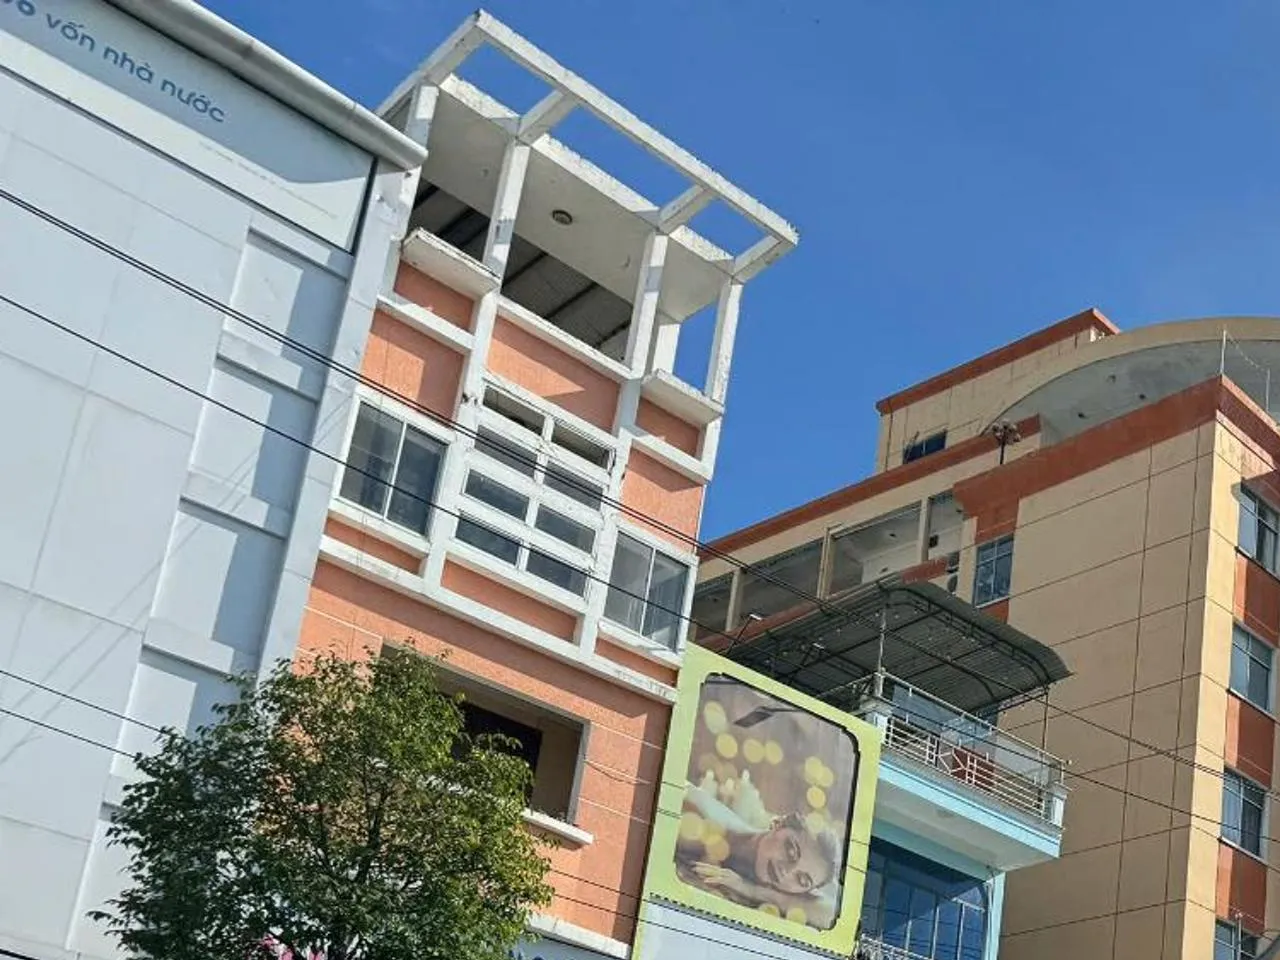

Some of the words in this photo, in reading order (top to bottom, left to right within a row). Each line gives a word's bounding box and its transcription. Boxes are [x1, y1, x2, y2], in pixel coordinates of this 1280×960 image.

[45, 12, 96, 53] vốn
[103, 46, 155, 84] nhà
[160, 79, 226, 123] nước
